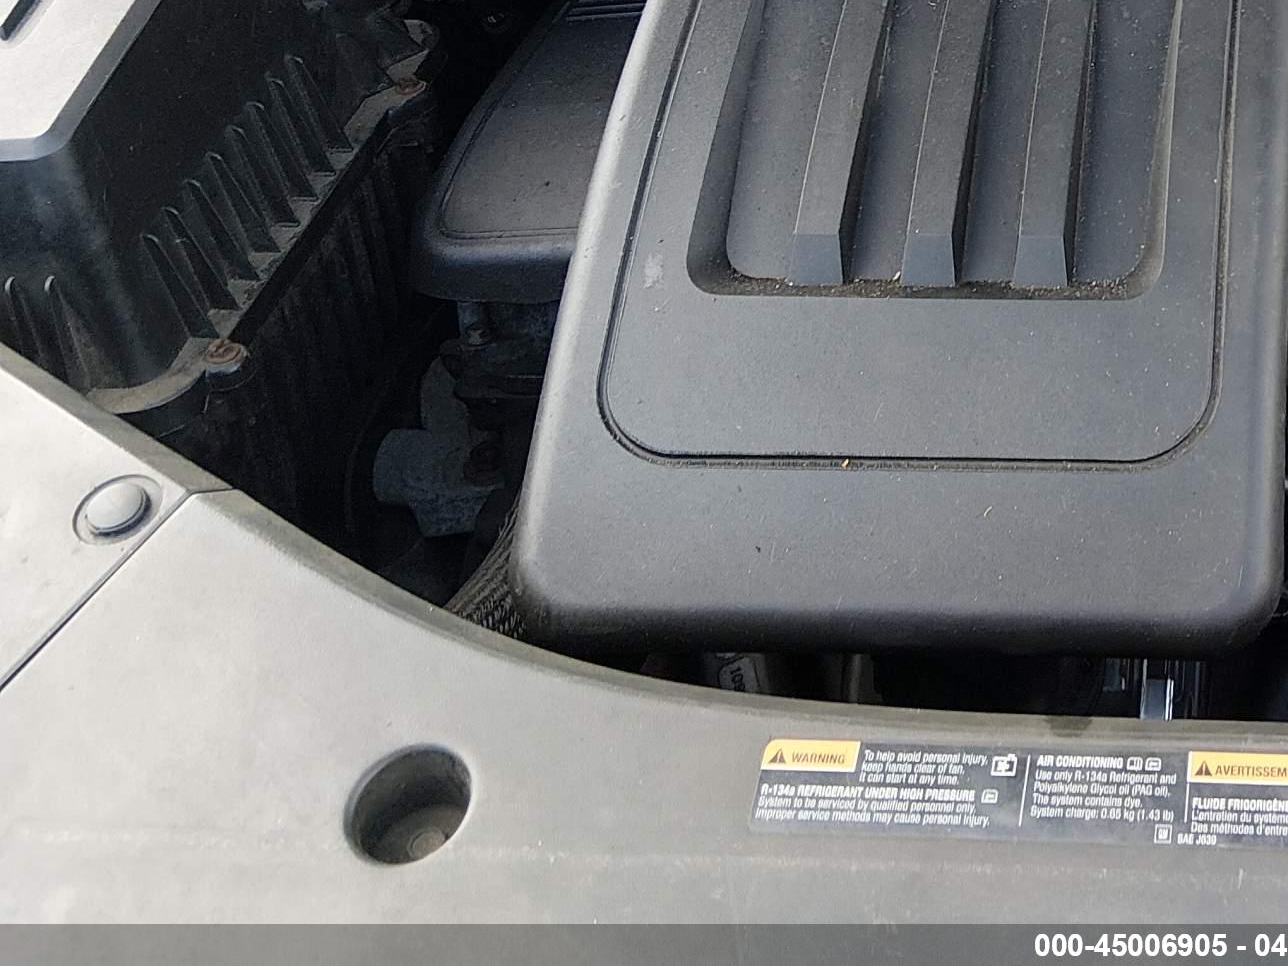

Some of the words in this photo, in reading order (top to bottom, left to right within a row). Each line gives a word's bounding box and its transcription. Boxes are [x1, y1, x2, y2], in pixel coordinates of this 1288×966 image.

[792, 752, 845, 764] WARNING
[864, 749, 874, 761] To
[876, 749, 895, 764] help
[896, 751, 921, 763] avoid
[922, 752, 960, 766] personal
[1037, 754, 1054, 767] AIR
[1055, 755, 1124, 769] CONDITIONING
[861, 761, 883, 774] keep
[885, 762, 912, 773] hands
[913, 763, 936, 773] clear
[937, 763, 947, 774] of
[867, 775, 884, 783] can
[885, 773, 907, 783] start
[908, 773, 918, 784] at
[919, 775, 936, 786] any
[937, 774, 960, 785] time.
[1035, 769, 1052, 780] Use
[1054, 770, 1073, 783] only
[1074, 770, 1107, 783] R-134a
[1109, 771, 1158, 785] Refrigerant
[1160, 773, 1177, 785] and
[760, 783, 796, 796] R-134a
[797, 784, 863, 798] REFRIGERANT
[864, 787, 898, 800] UNDER
[899, 788, 923, 801] HIGH
[924, 788, 976, 802] PRESSURE
[1033, 781, 1088, 795] Polyalkylene
[1090, 783, 1117, 796] Glycol
[1119, 783, 1130, 795] oil
[1131, 783, 1153, 796] (PAG
[758, 796, 792, 808] System
[793, 796, 802, 806] to
[804, 797, 816, 806] be
[817, 797, 856, 807] serviced
[857, 799, 869, 811] by
[870, 800, 909, 812] qualified
[910, 801, 954, 813] personnel
[1032, 793, 1049, 805] The
[1050, 795, 1083, 807] system
[1084, 795, 1123, 808] contains
[1124, 796, 1143, 809] dye.
[1192, 797, 1226, 810] FLUIDE
[755, 808, 796, 821] Improper
[797, 809, 830, 821] service
[832, 810, 871, 822] methods
[872, 813, 892, 825] may
[894, 813, 921, 824] cause
[922, 813, 961, 826] personal
[1030, 806, 1064, 819] System
[1065, 807, 1099, 820] charge:
[1101, 807, 1122, 820] 0.65
[1123, 809, 1135, 822] kg
[1137, 809, 1161, 822] (1.43
[1163, 810, 1174, 823] lb)
